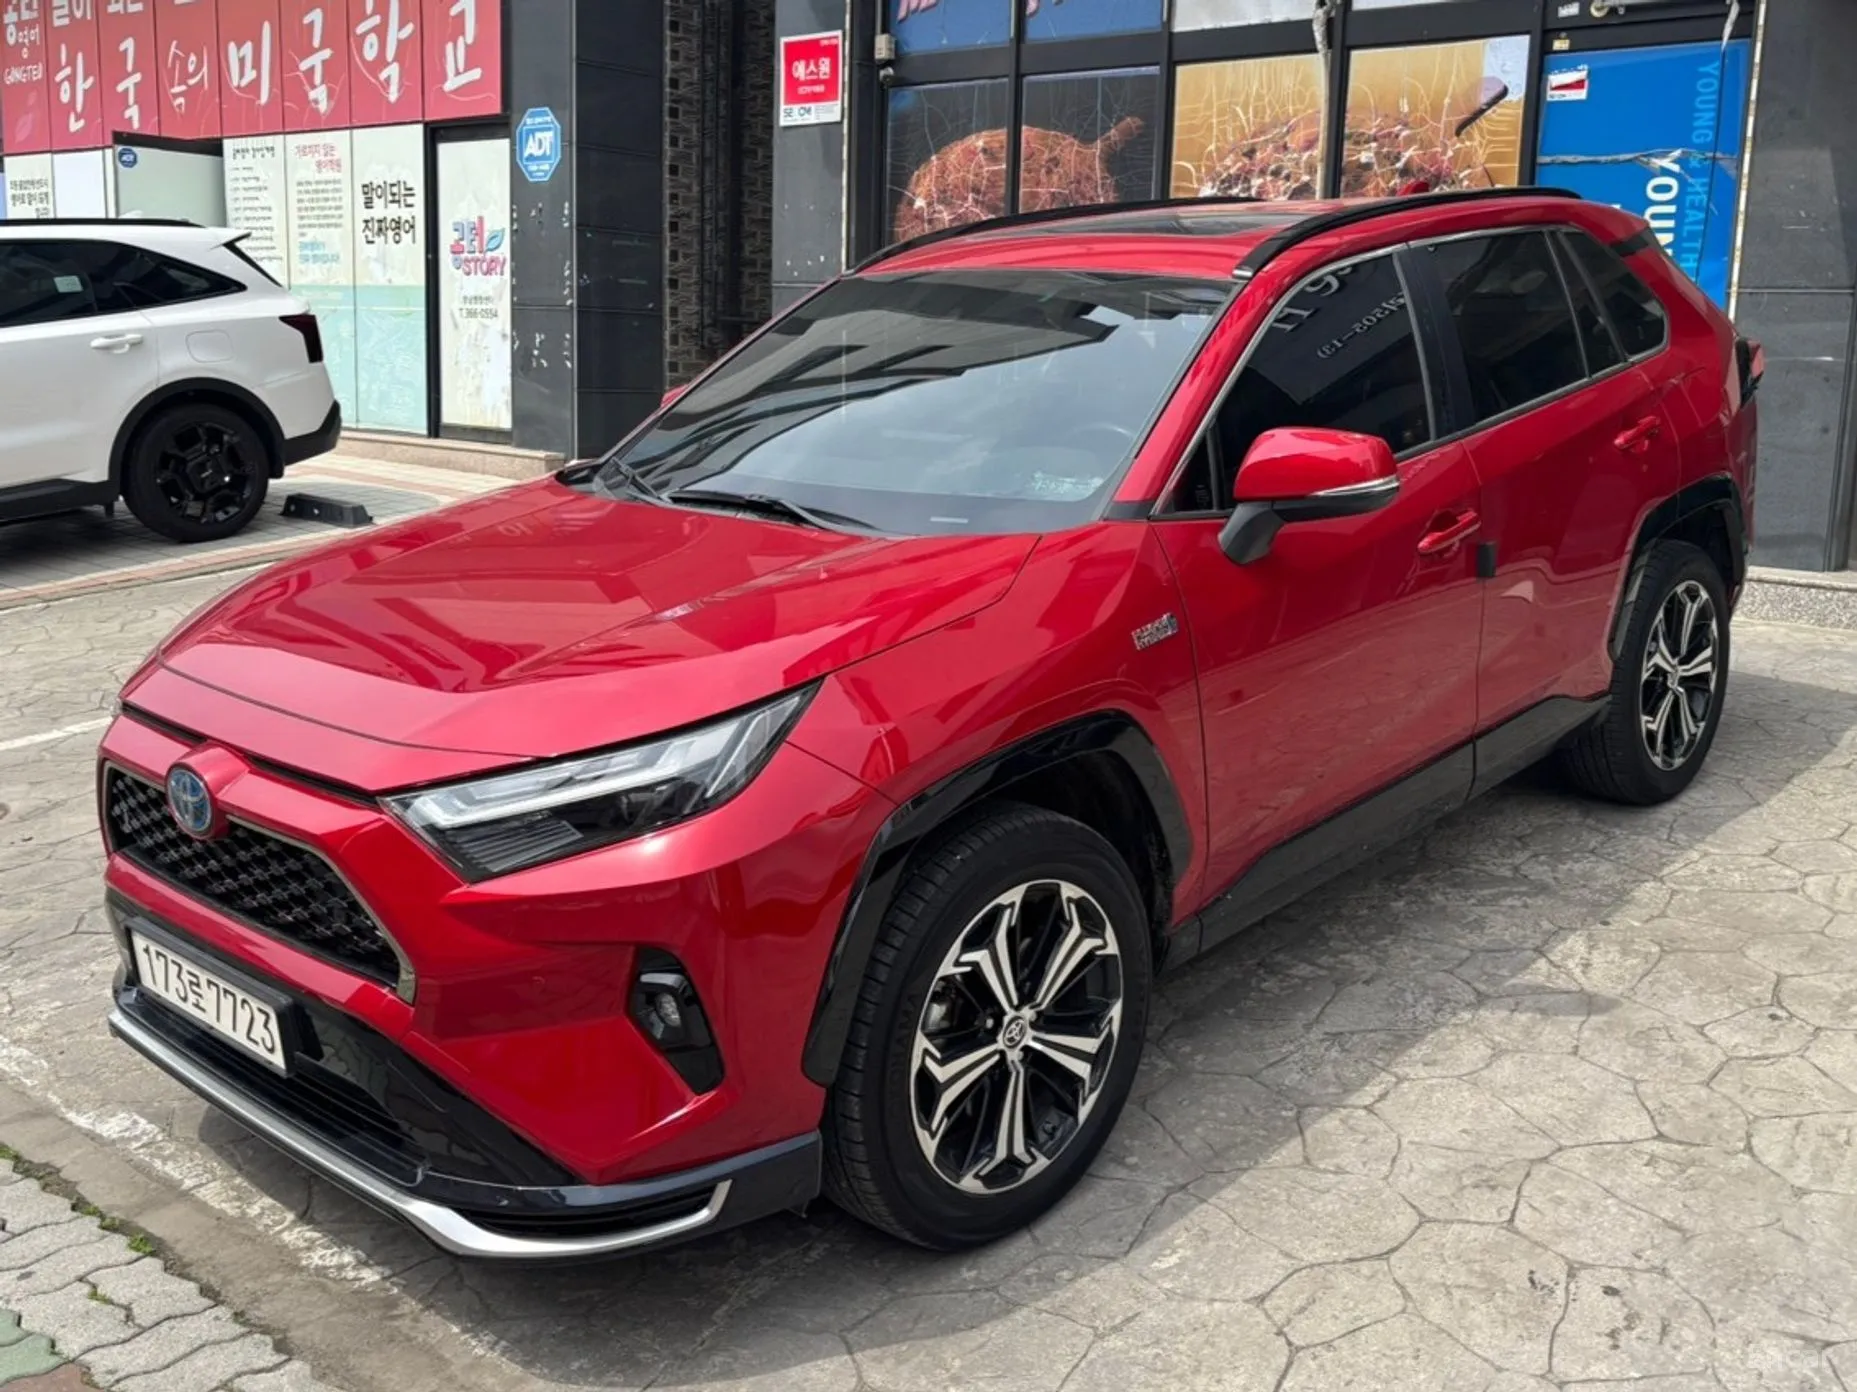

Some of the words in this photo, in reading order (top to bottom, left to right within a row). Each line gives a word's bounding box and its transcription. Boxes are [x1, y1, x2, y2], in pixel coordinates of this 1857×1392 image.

[792, 57, 831, 81] 에스원
[1690, 60, 1720, 145] YOUNG
[524, 131, 553, 157] ADT
[361, 181, 416, 209] 말이되는
[361, 216, 416, 245] 진짜영어
[1680, 177, 1709, 284] HEALTH
[462, 255, 507, 276] STORY
